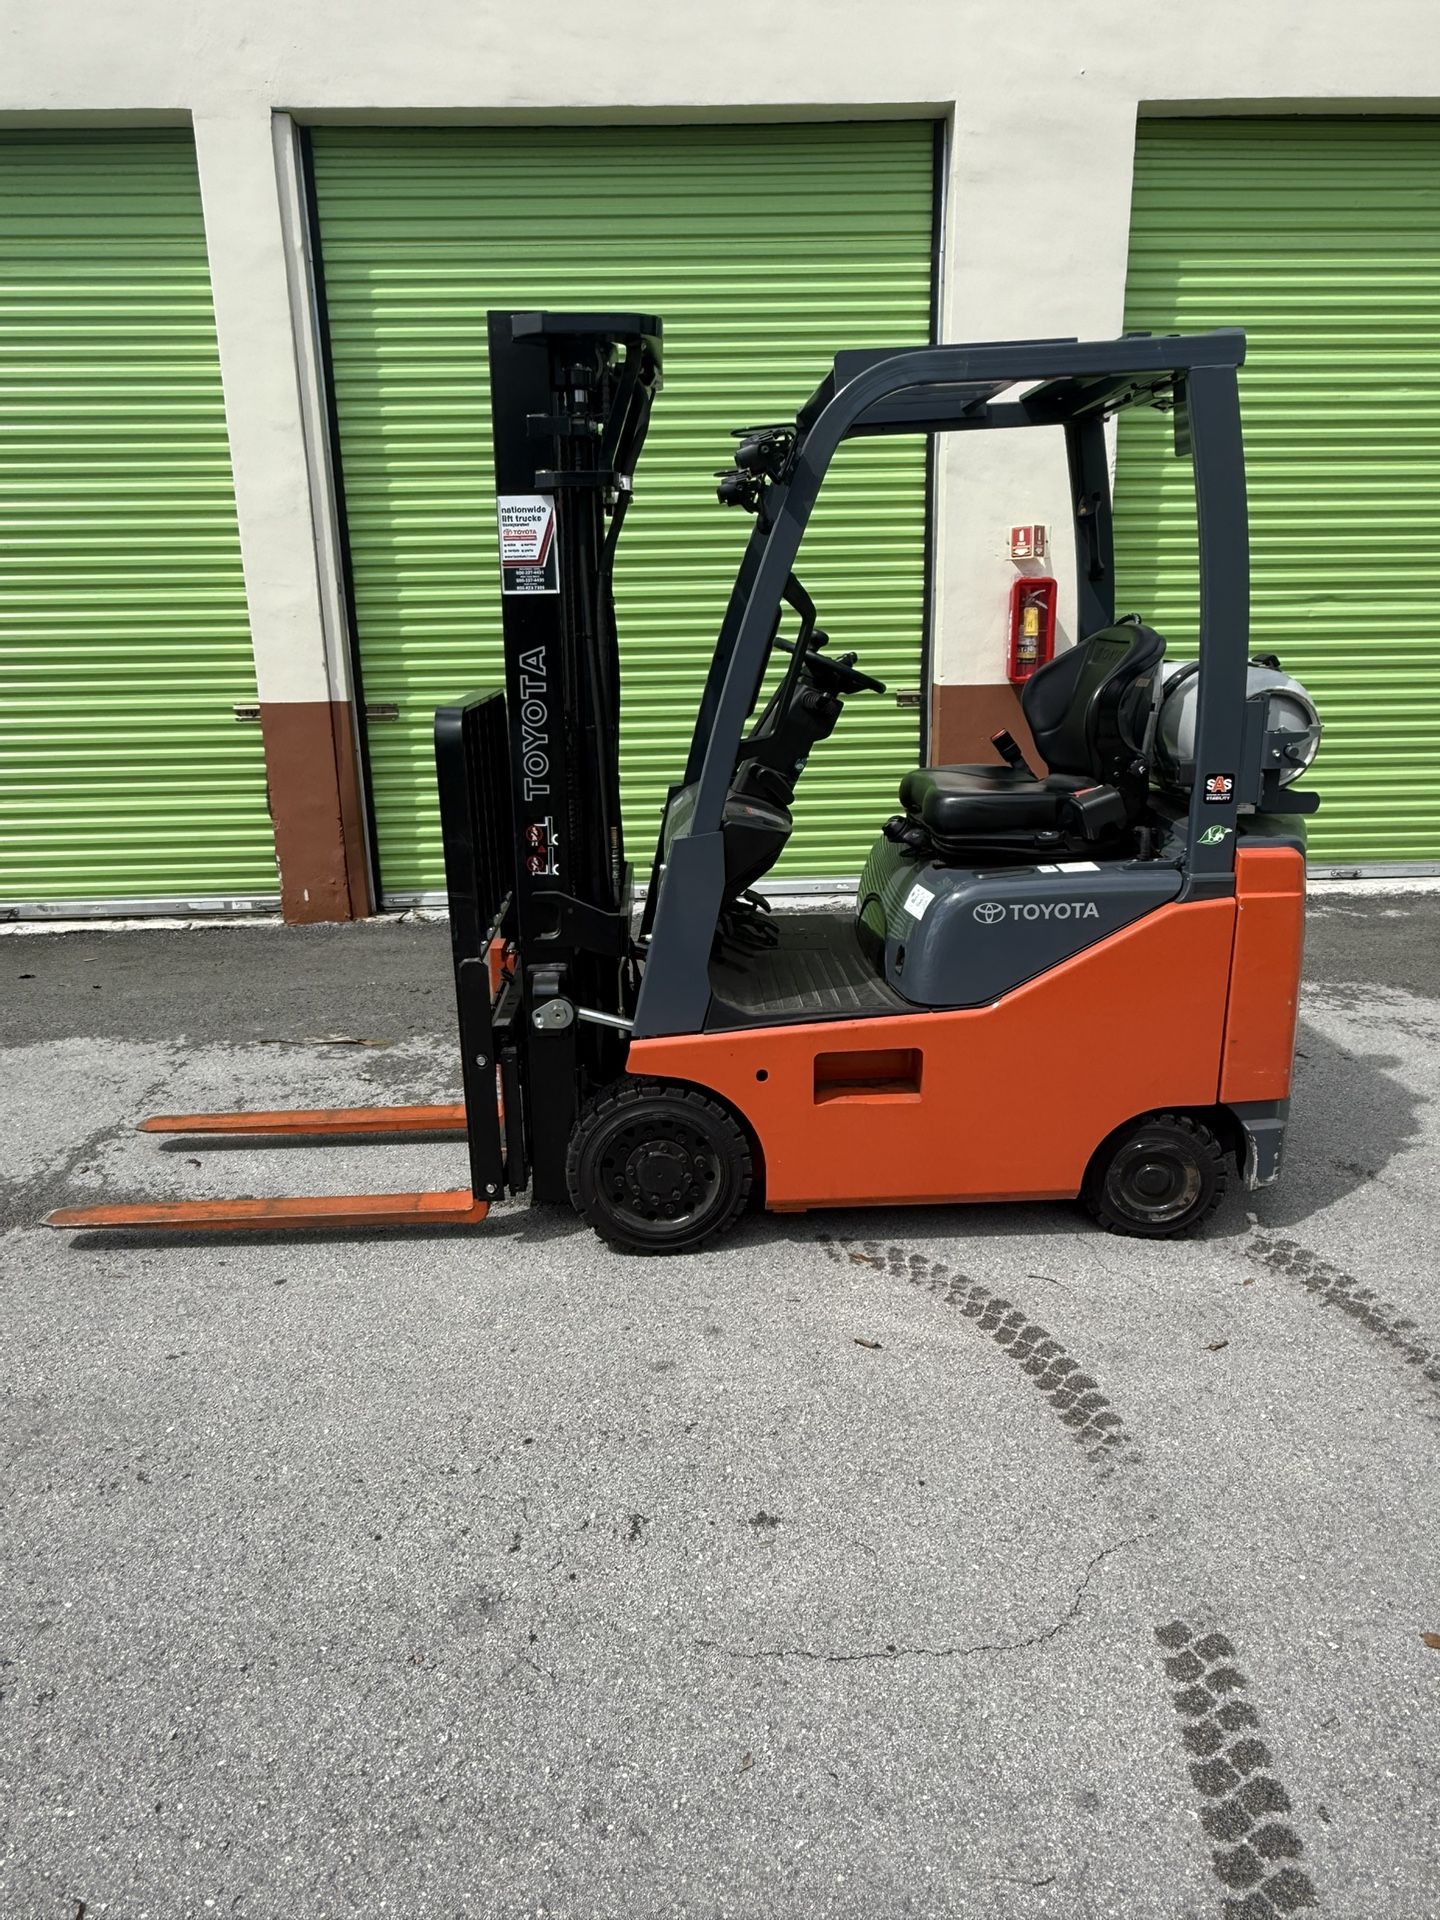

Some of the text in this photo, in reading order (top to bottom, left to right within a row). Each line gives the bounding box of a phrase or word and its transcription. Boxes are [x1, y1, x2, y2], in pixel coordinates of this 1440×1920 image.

[519, 645, 550, 801] TOYOTA
[1206, 776, 1232, 792] SAS
[1009, 902, 1100, 921] TOYOTA
